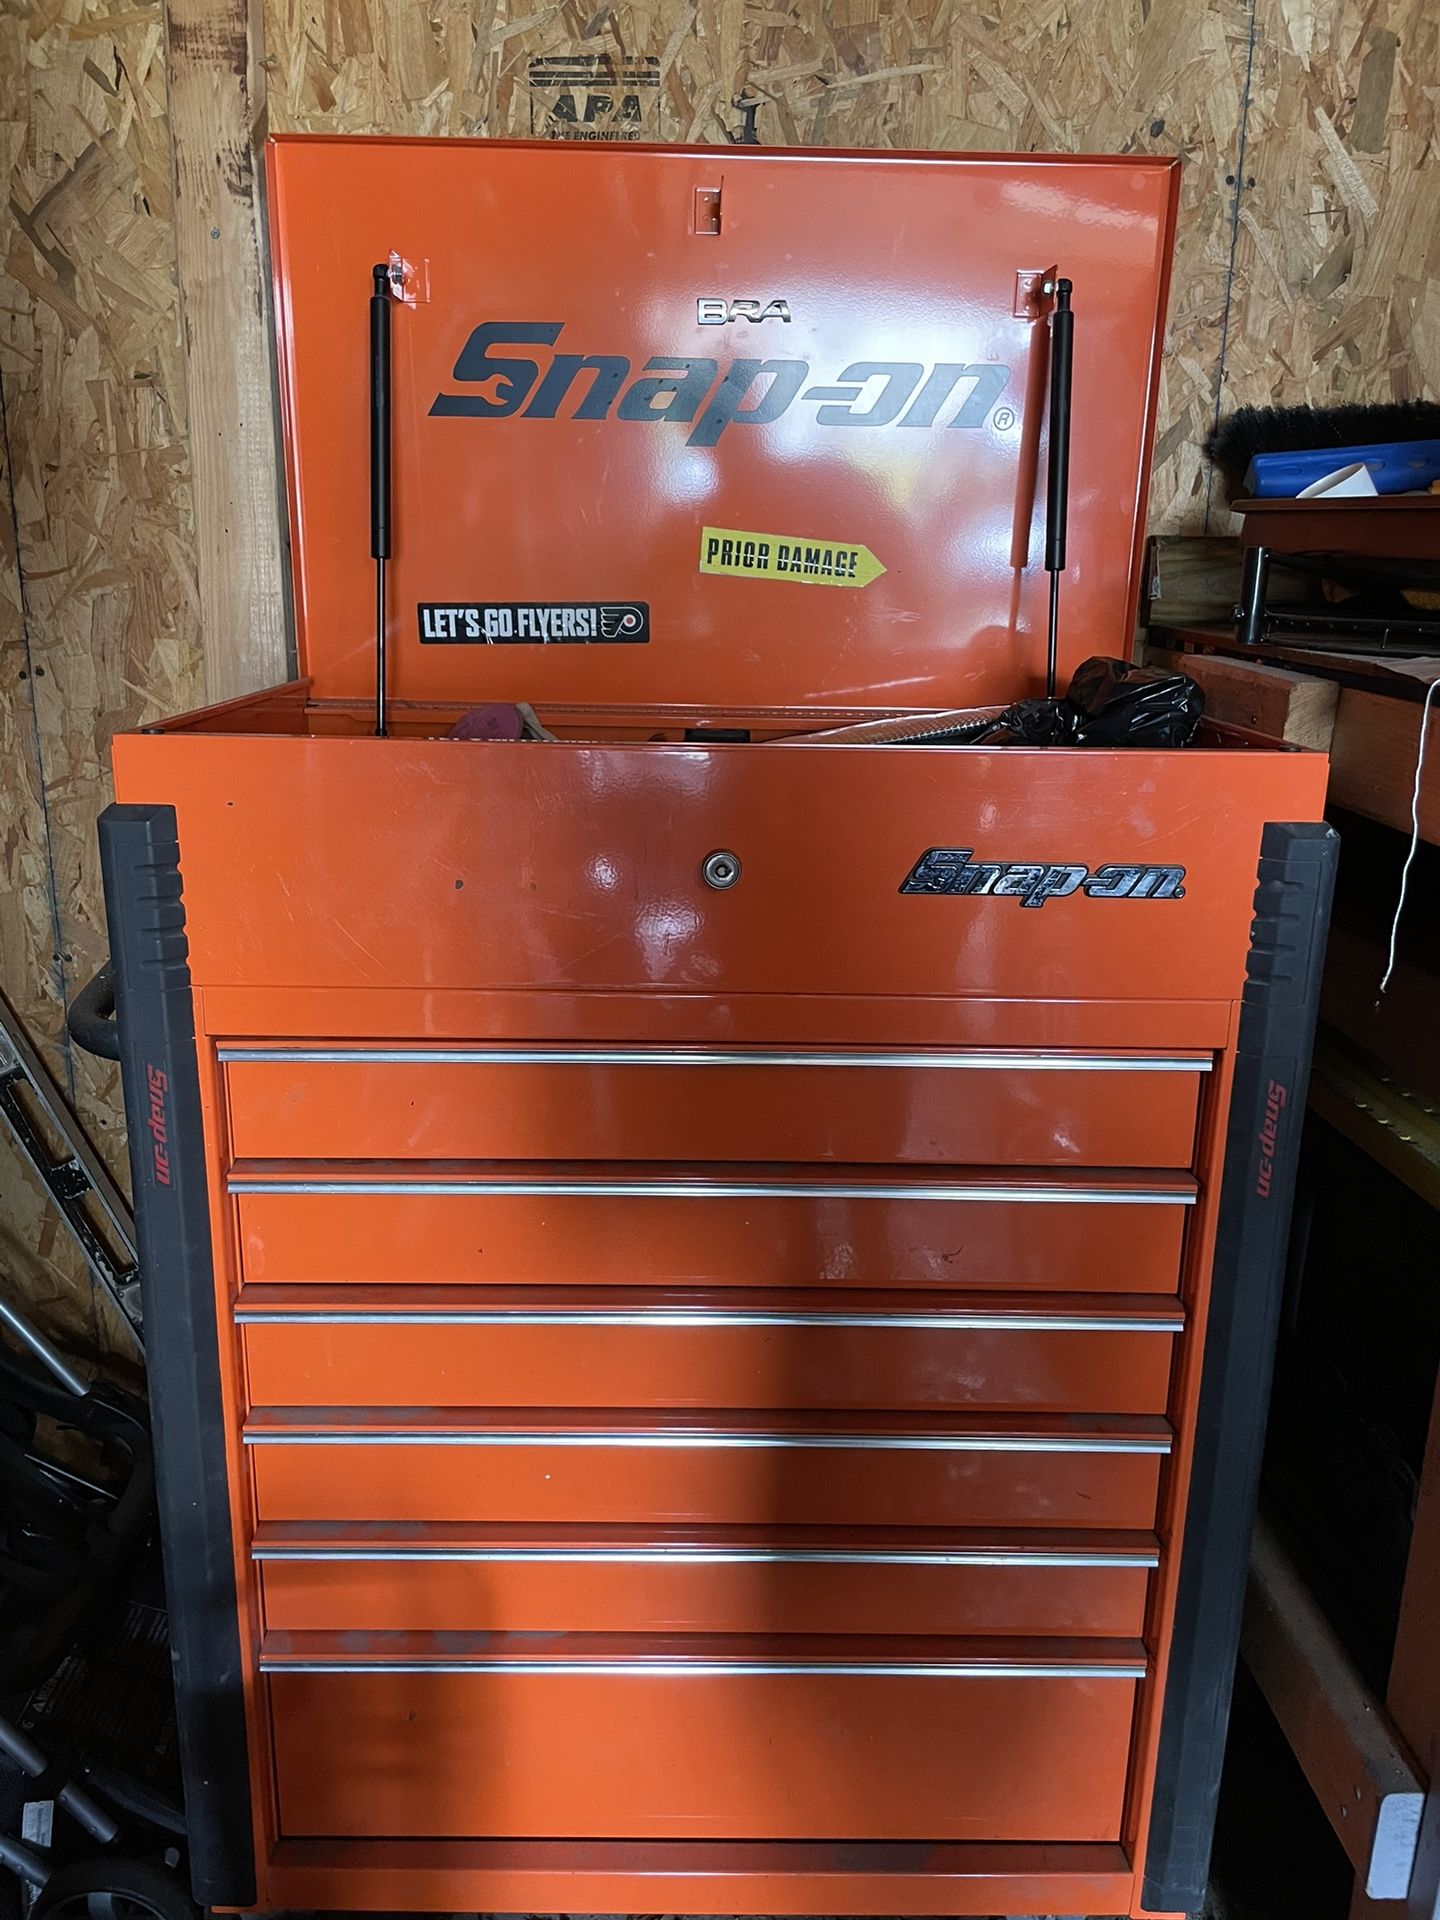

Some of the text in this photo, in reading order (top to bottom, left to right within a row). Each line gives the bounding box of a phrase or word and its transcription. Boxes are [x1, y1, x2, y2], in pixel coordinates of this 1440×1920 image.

[549, 94, 642, 122] APA
[697, 298, 791, 325] BRA
[707, 538, 858, 578] PRIOR DAMAGE
[423, 607, 597, 638] LET'S GO FLYERS!
[147, 1064, 171, 1186] Snap-on
[1256, 1079, 1288, 1198] Snap-on
